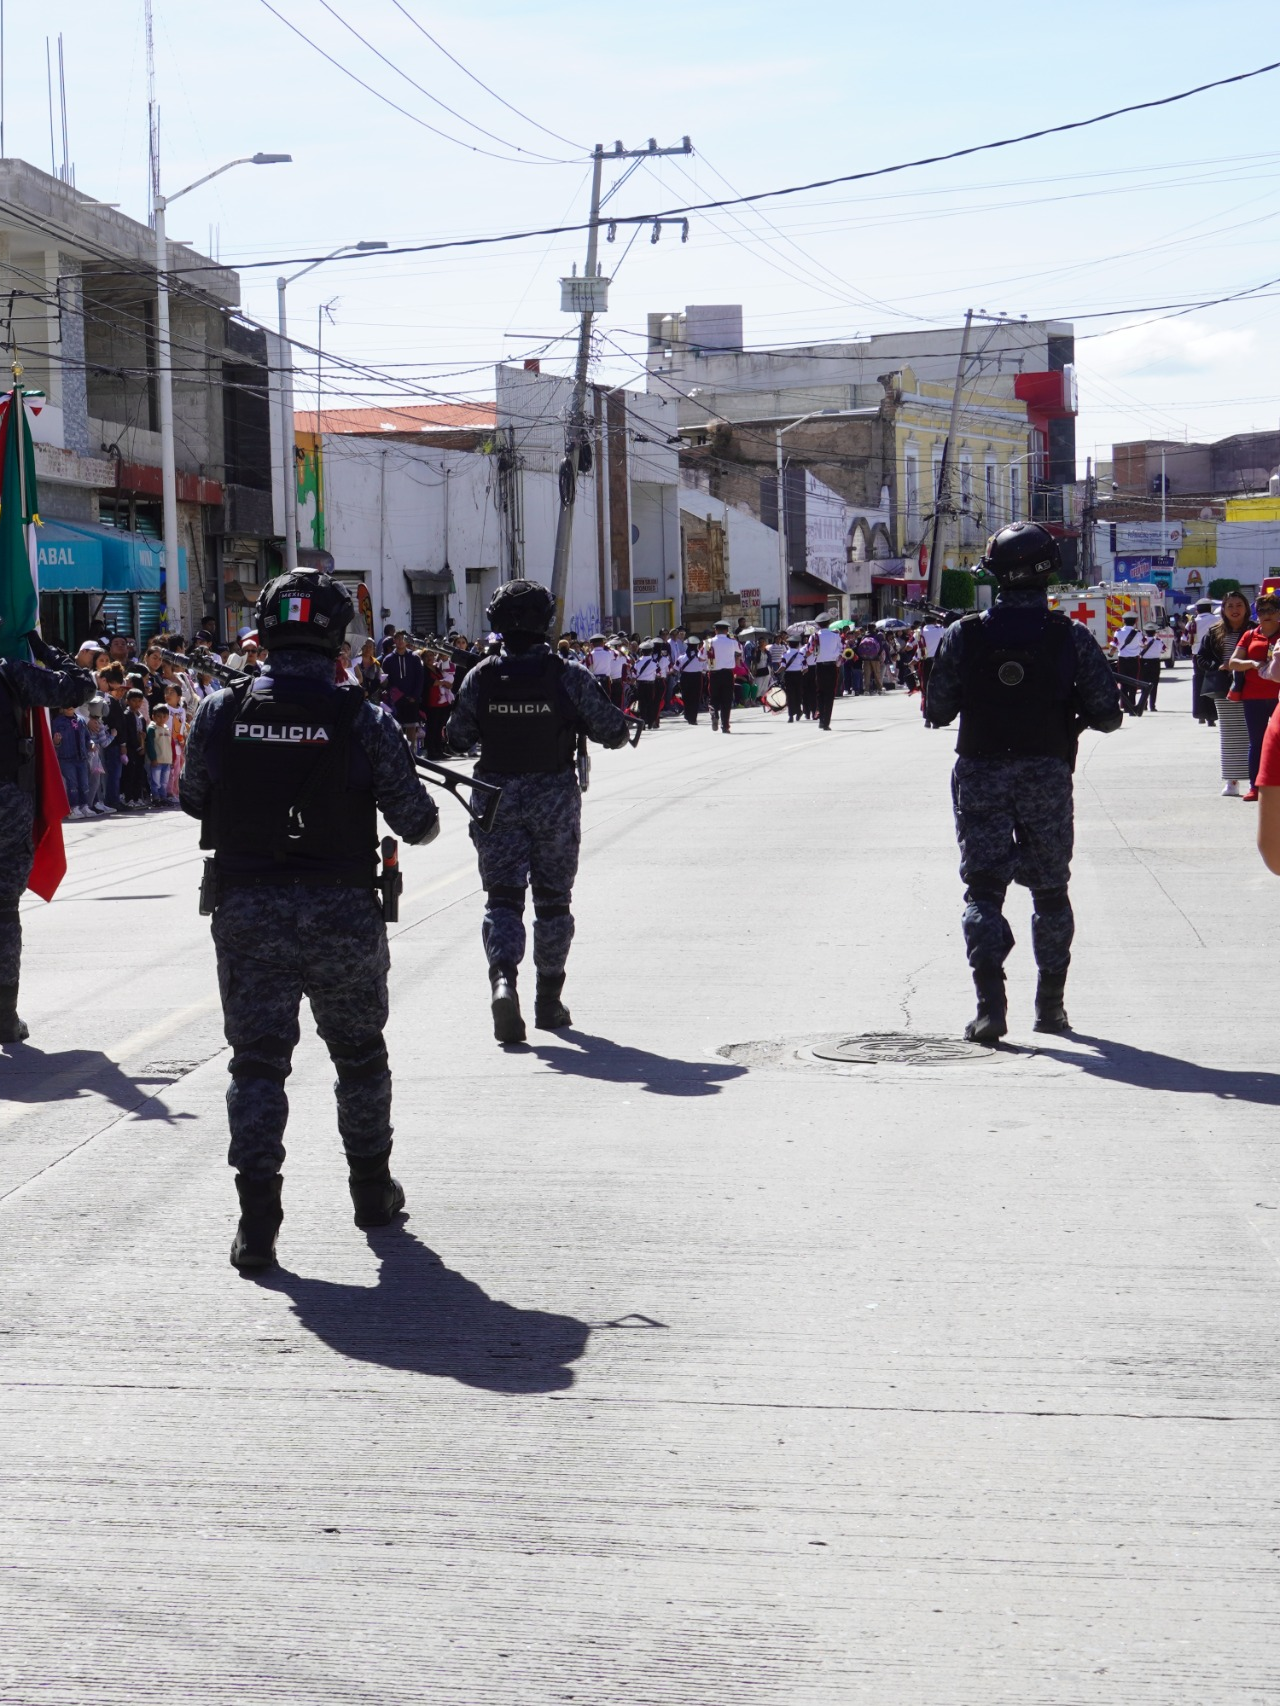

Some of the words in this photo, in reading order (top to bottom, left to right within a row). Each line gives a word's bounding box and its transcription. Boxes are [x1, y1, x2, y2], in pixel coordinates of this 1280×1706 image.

[38, 548, 75, 565] ABAL
[741, 589, 760, 598] SERVICIO
[488, 703, 552, 714] POLICIA
[235, 724, 329, 741] POLICIA
